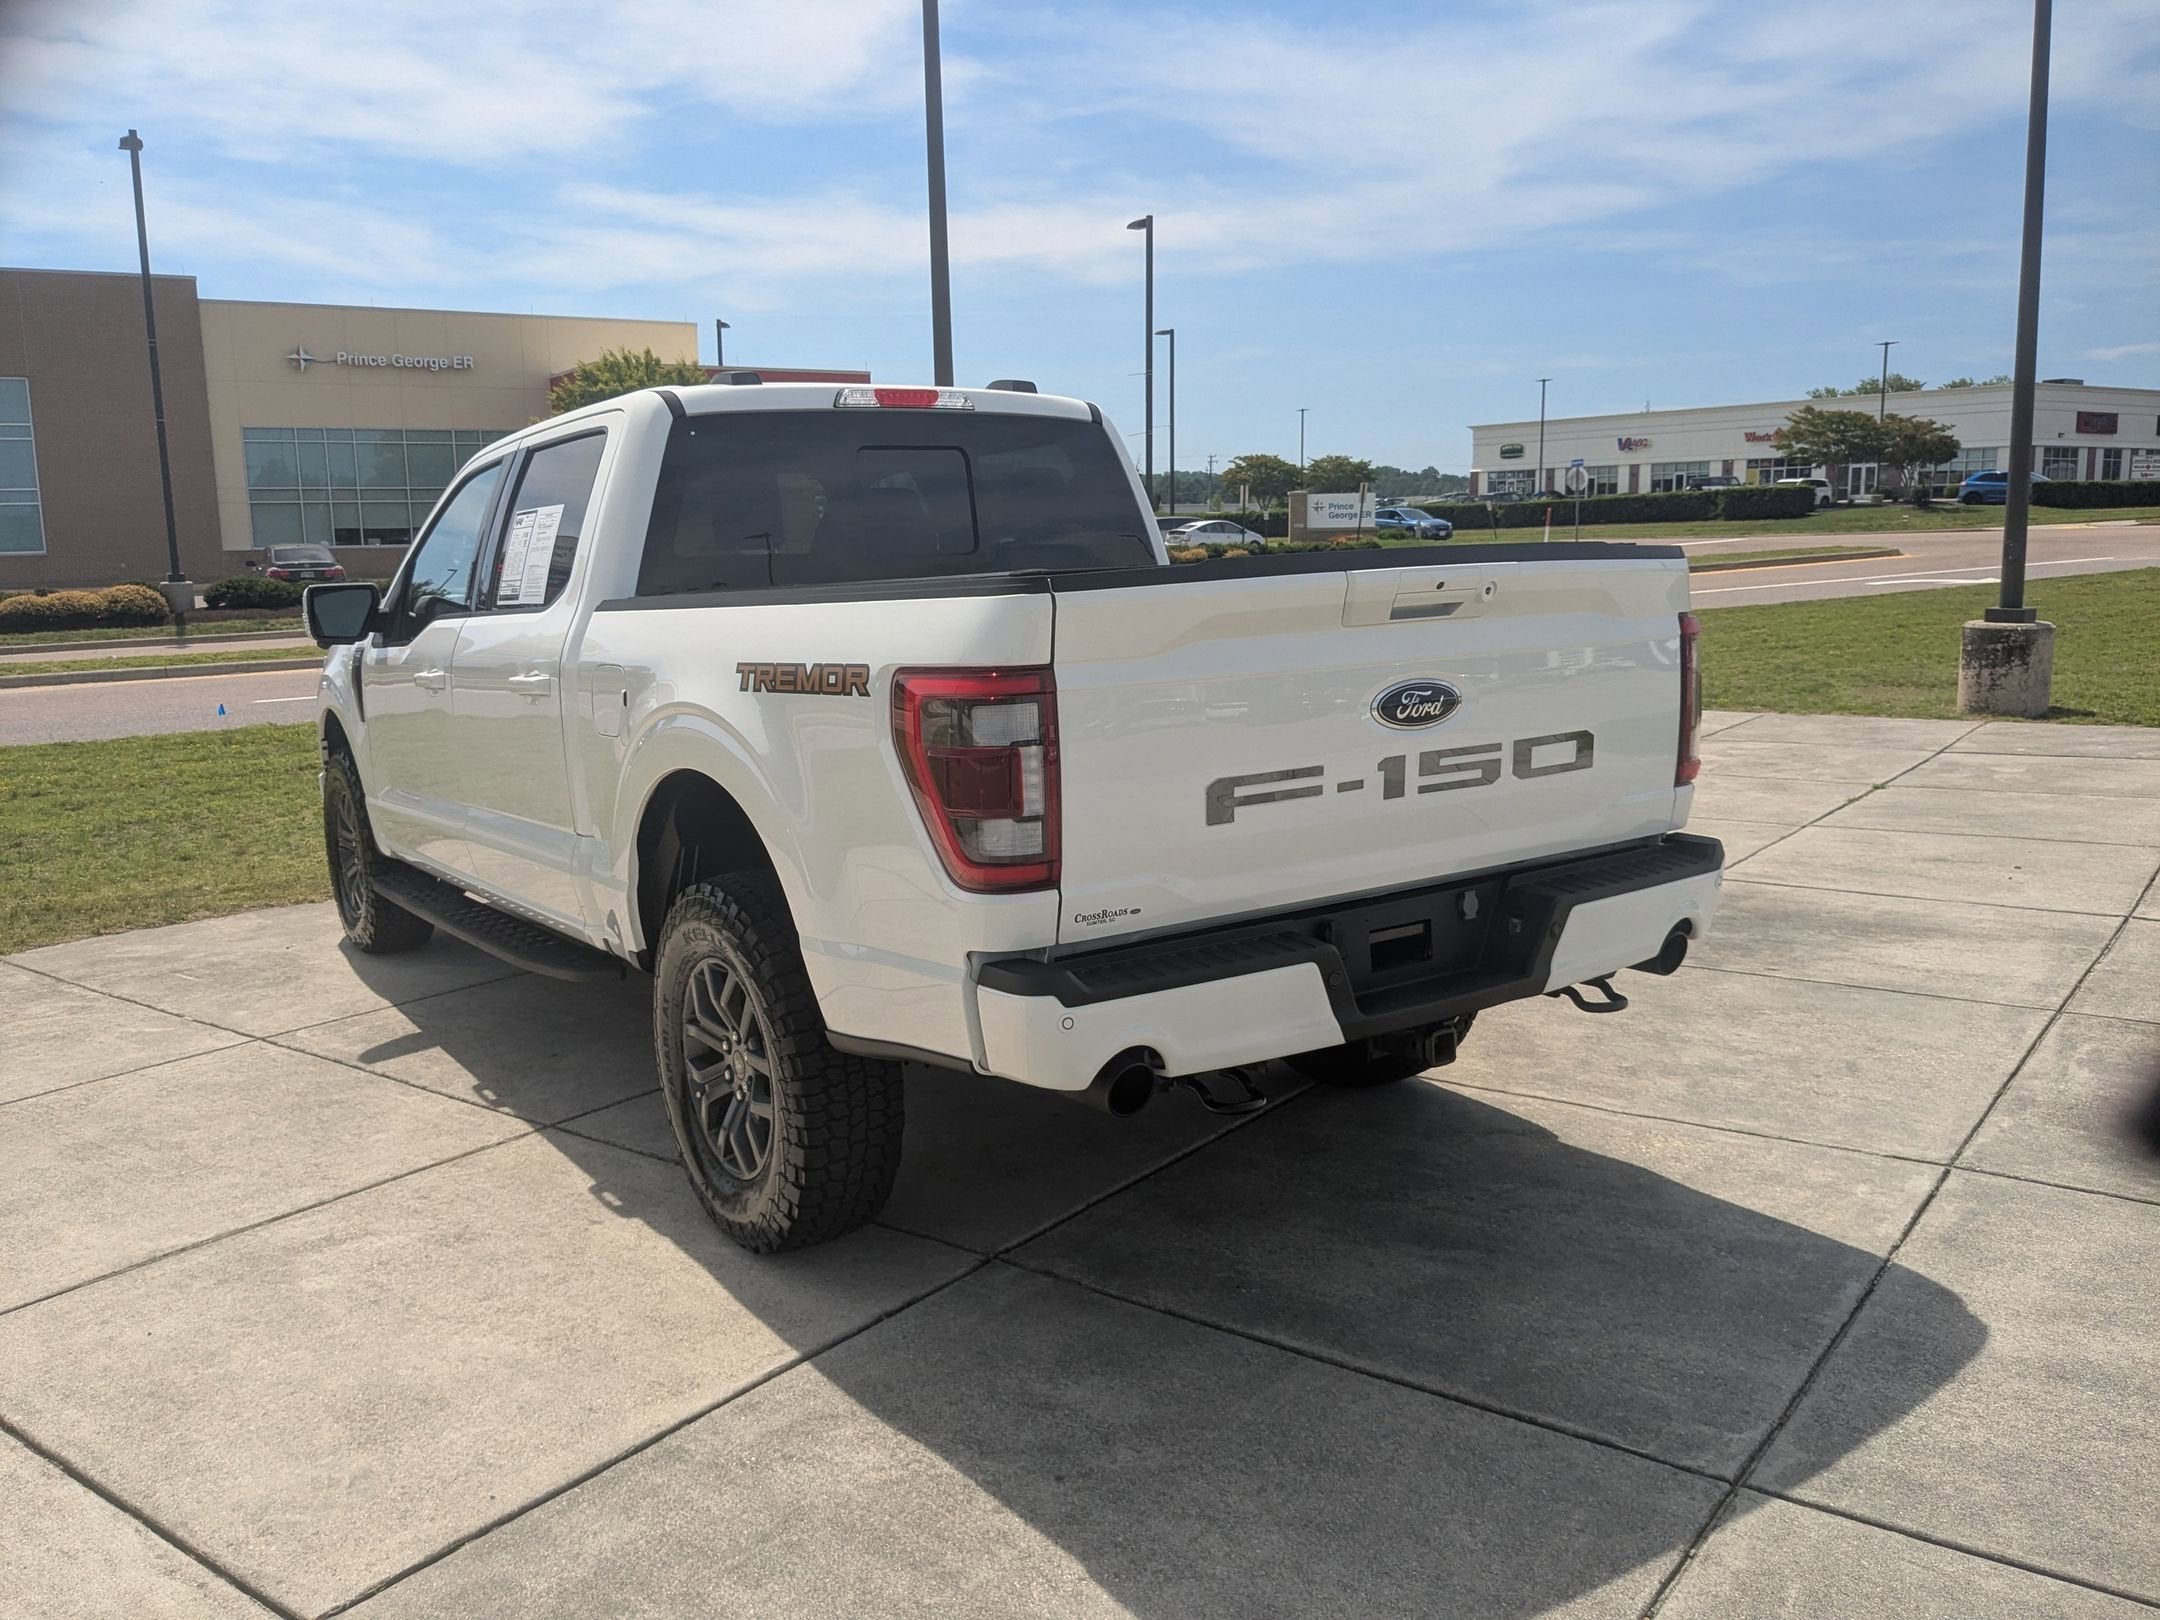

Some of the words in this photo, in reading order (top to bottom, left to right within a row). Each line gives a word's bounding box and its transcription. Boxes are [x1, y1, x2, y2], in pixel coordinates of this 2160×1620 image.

[336, 352, 387, 367] Prince
[392, 354, 448, 371] George
[453, 356, 474, 369] ER
[1328, 511, 1358, 520] George
[735, 662, 871, 697] TREMOR
[1396, 690, 1445, 719] Ford
[1206, 730, 1595, 826] F-150
